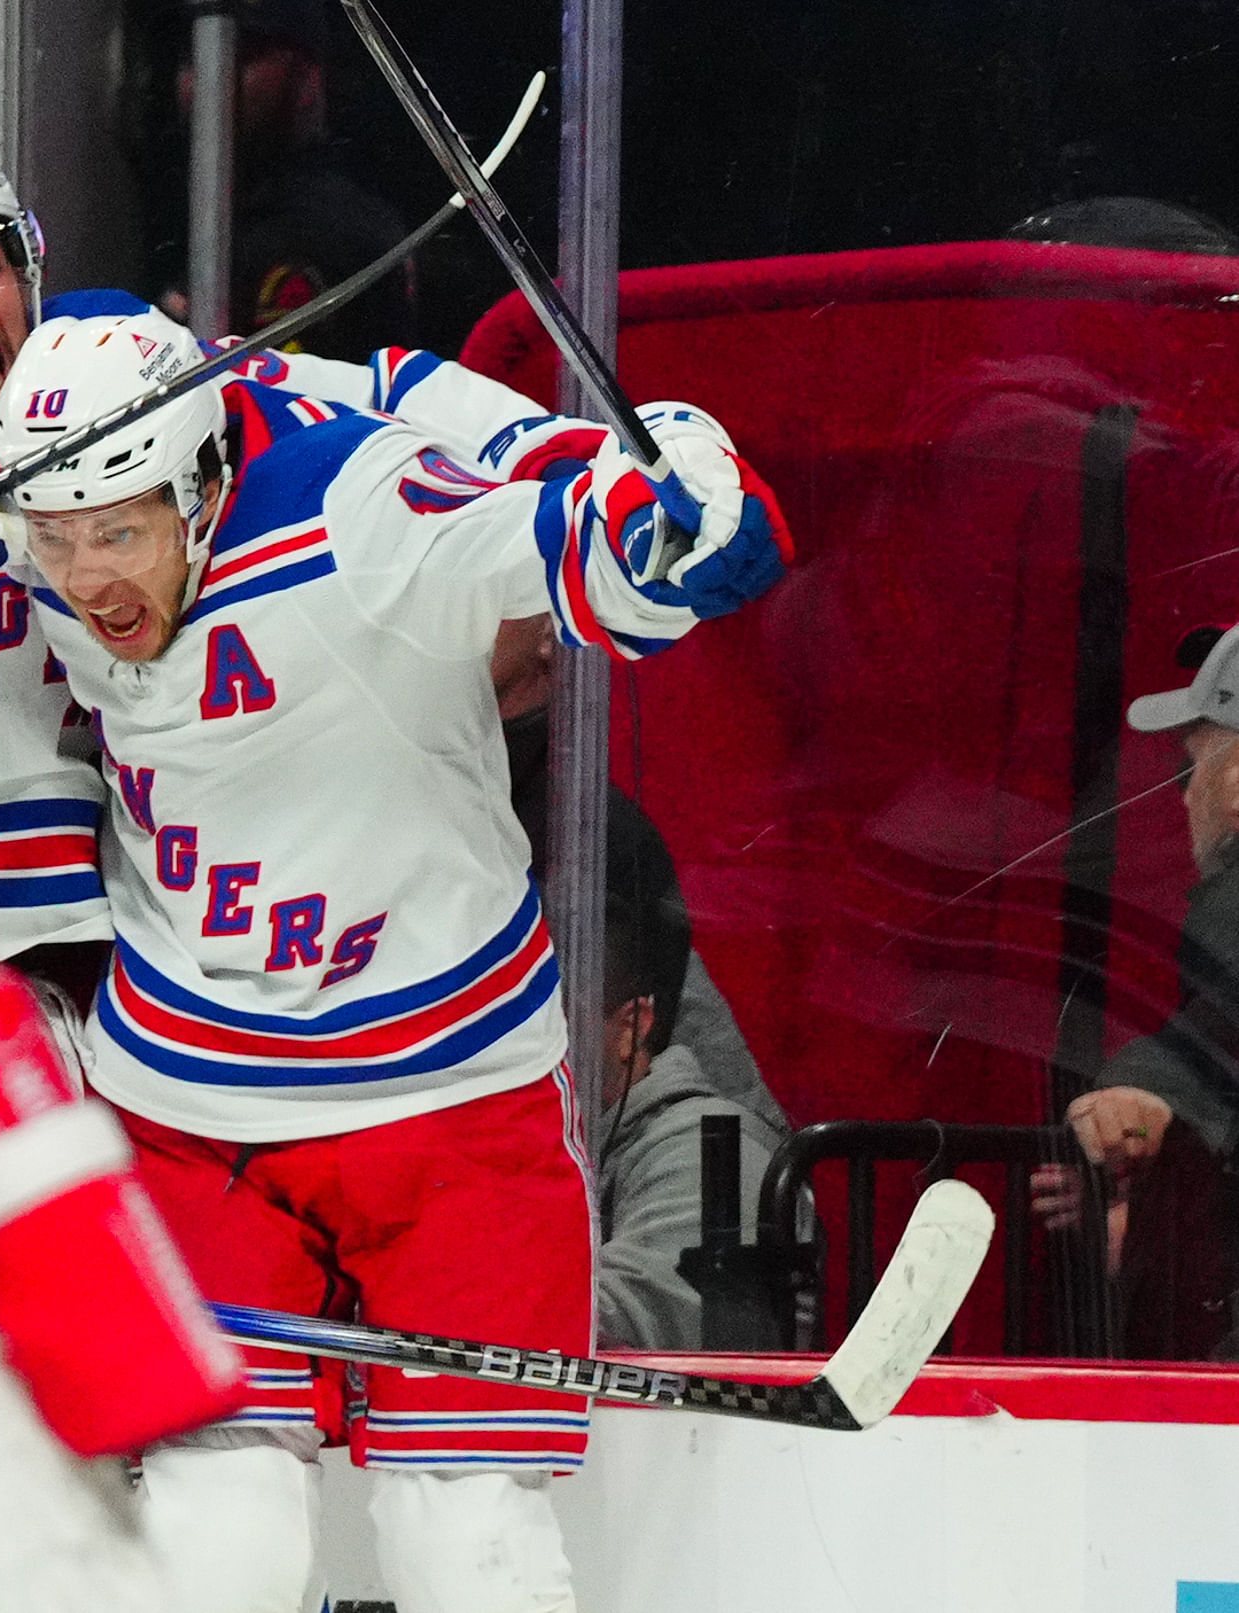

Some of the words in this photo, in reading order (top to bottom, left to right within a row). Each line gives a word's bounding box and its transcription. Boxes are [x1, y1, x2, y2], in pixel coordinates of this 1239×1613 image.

[25, 388, 69, 419] 10
[200, 624, 276, 720] A
[92, 706, 389, 991] NGERS
